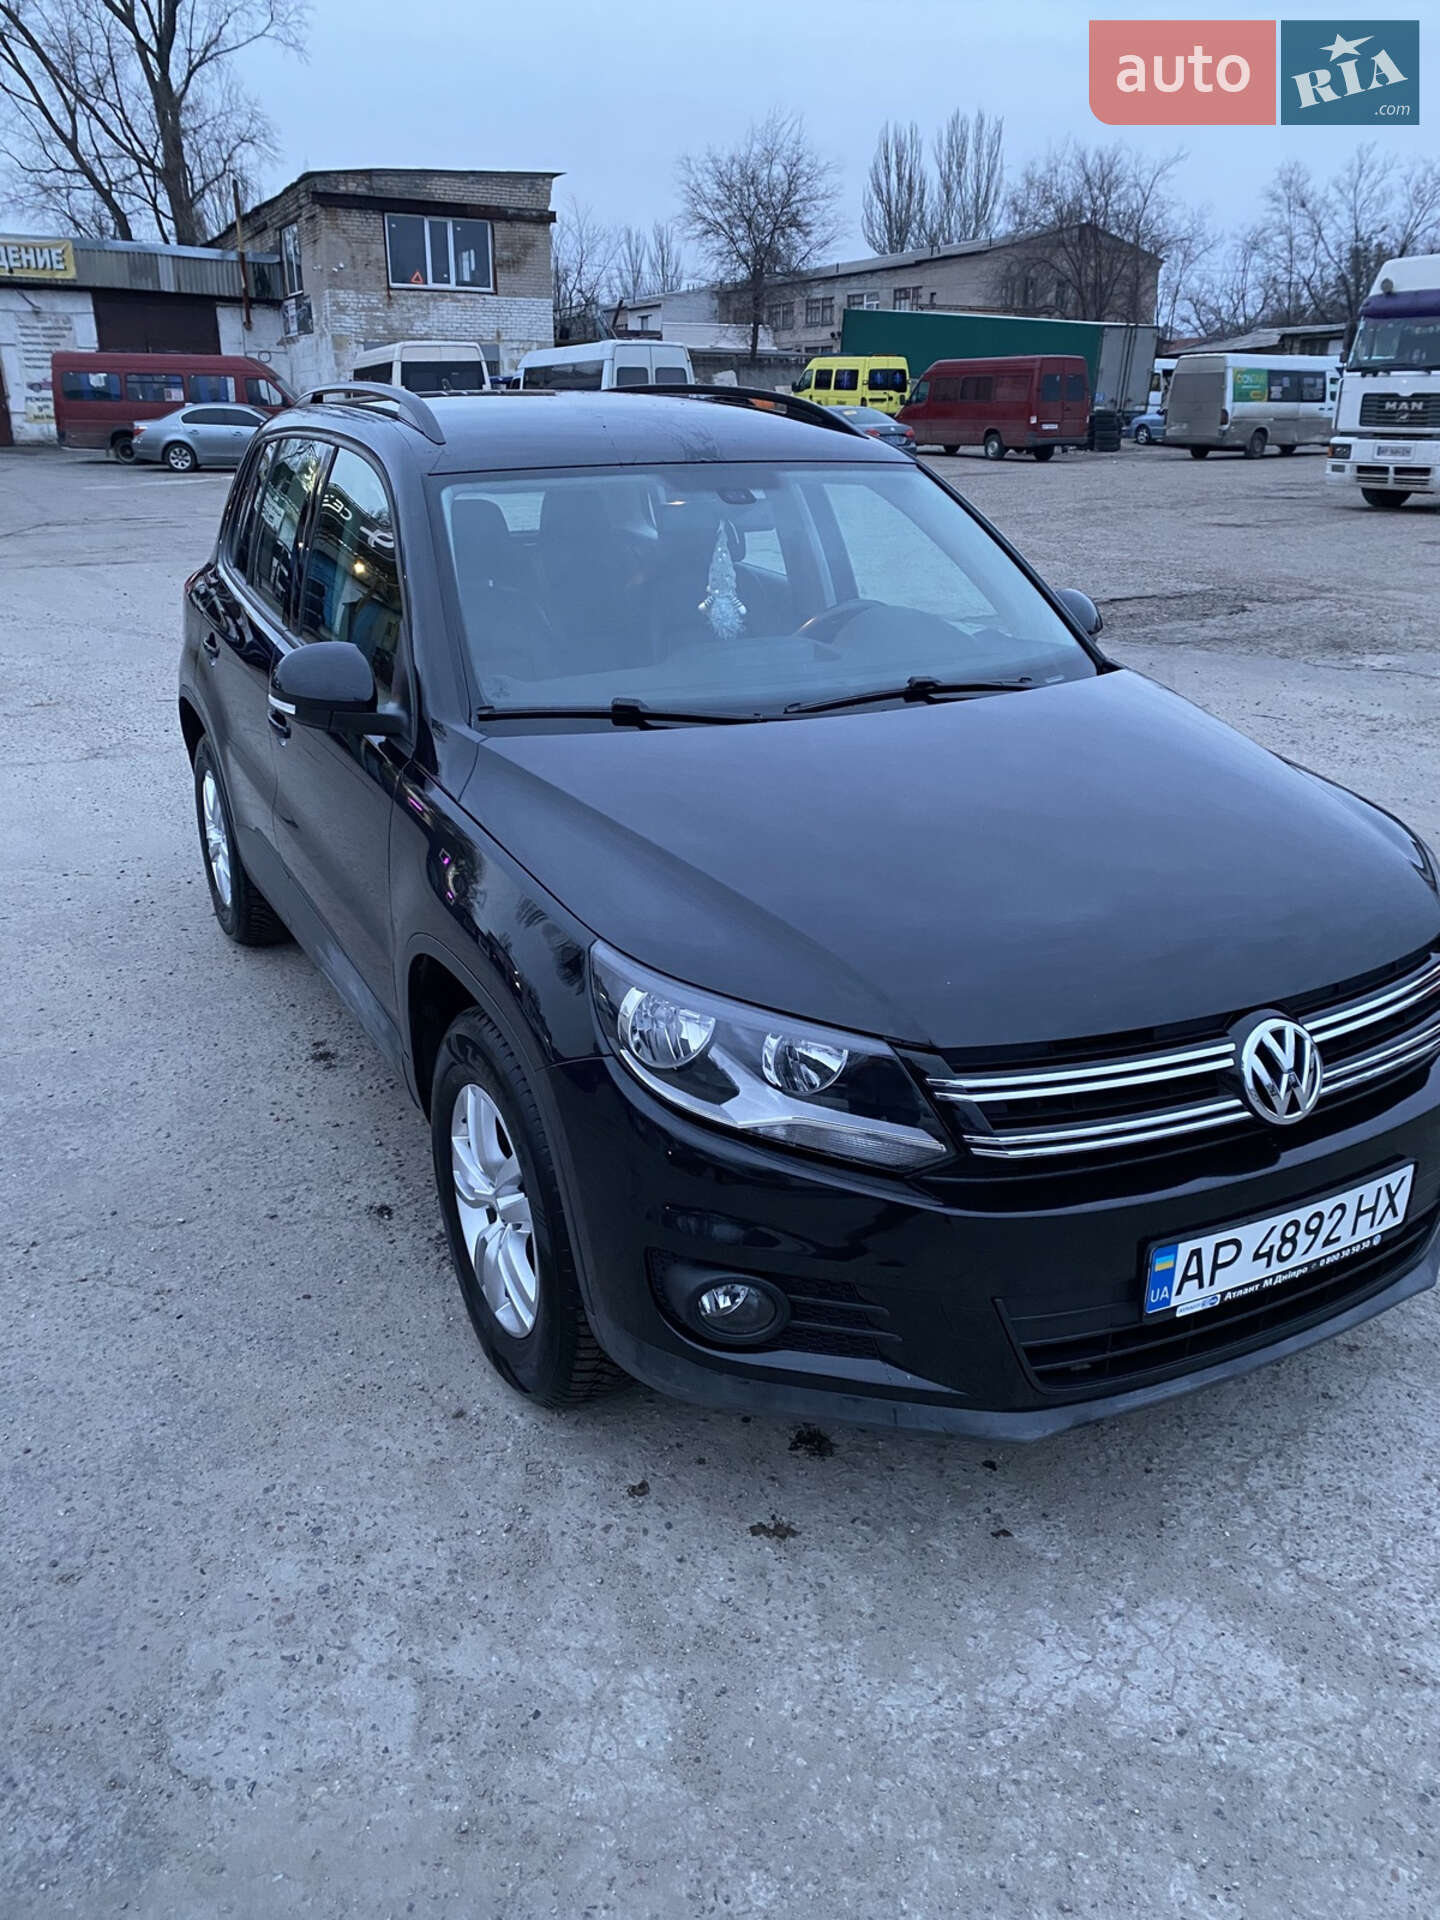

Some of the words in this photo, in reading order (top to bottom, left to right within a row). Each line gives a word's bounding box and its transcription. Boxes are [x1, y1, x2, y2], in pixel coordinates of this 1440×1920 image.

[1385, 401, 1424, 410] MAN
[1252, 1202, 1347, 1269] 4892
[1150, 1285, 1170, 1303] UA
